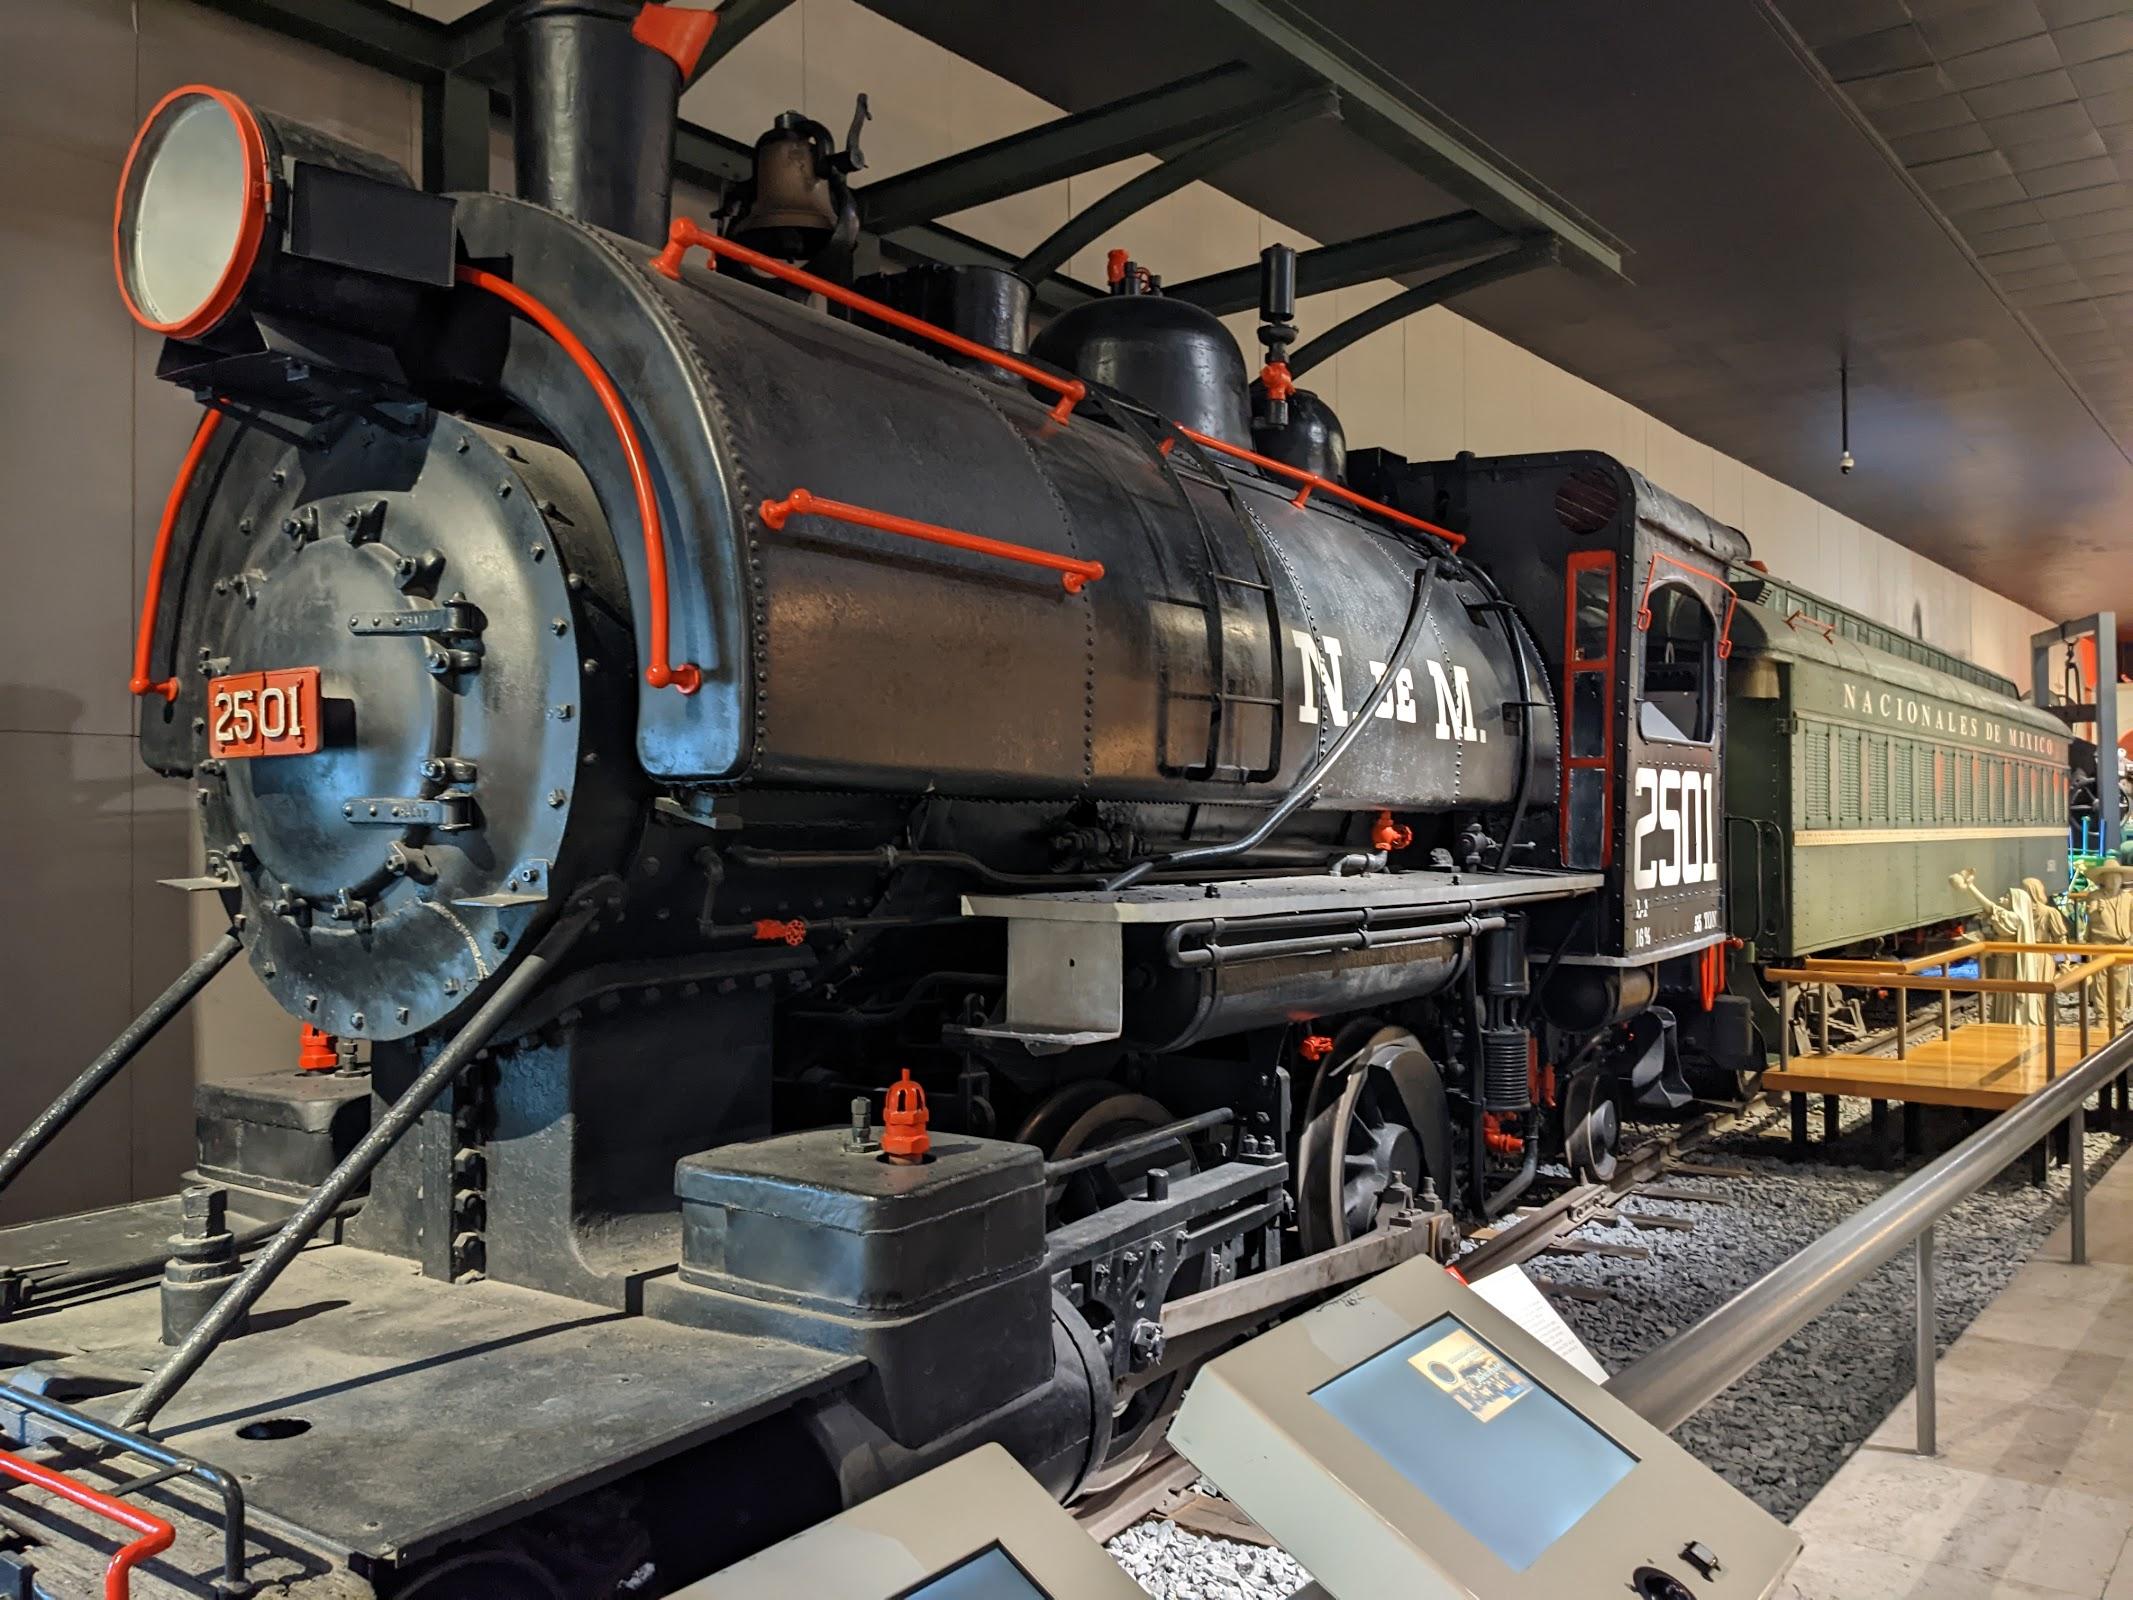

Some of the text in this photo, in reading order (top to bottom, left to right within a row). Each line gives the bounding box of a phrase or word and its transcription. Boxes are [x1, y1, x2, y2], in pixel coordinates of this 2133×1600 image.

[215, 686, 301, 741] 2501
[1426, 659, 1486, 744] M.
[1843, 683, 2054, 756] NACIONALES DE MEXICO
[1633, 766, 1718, 891] 2501
